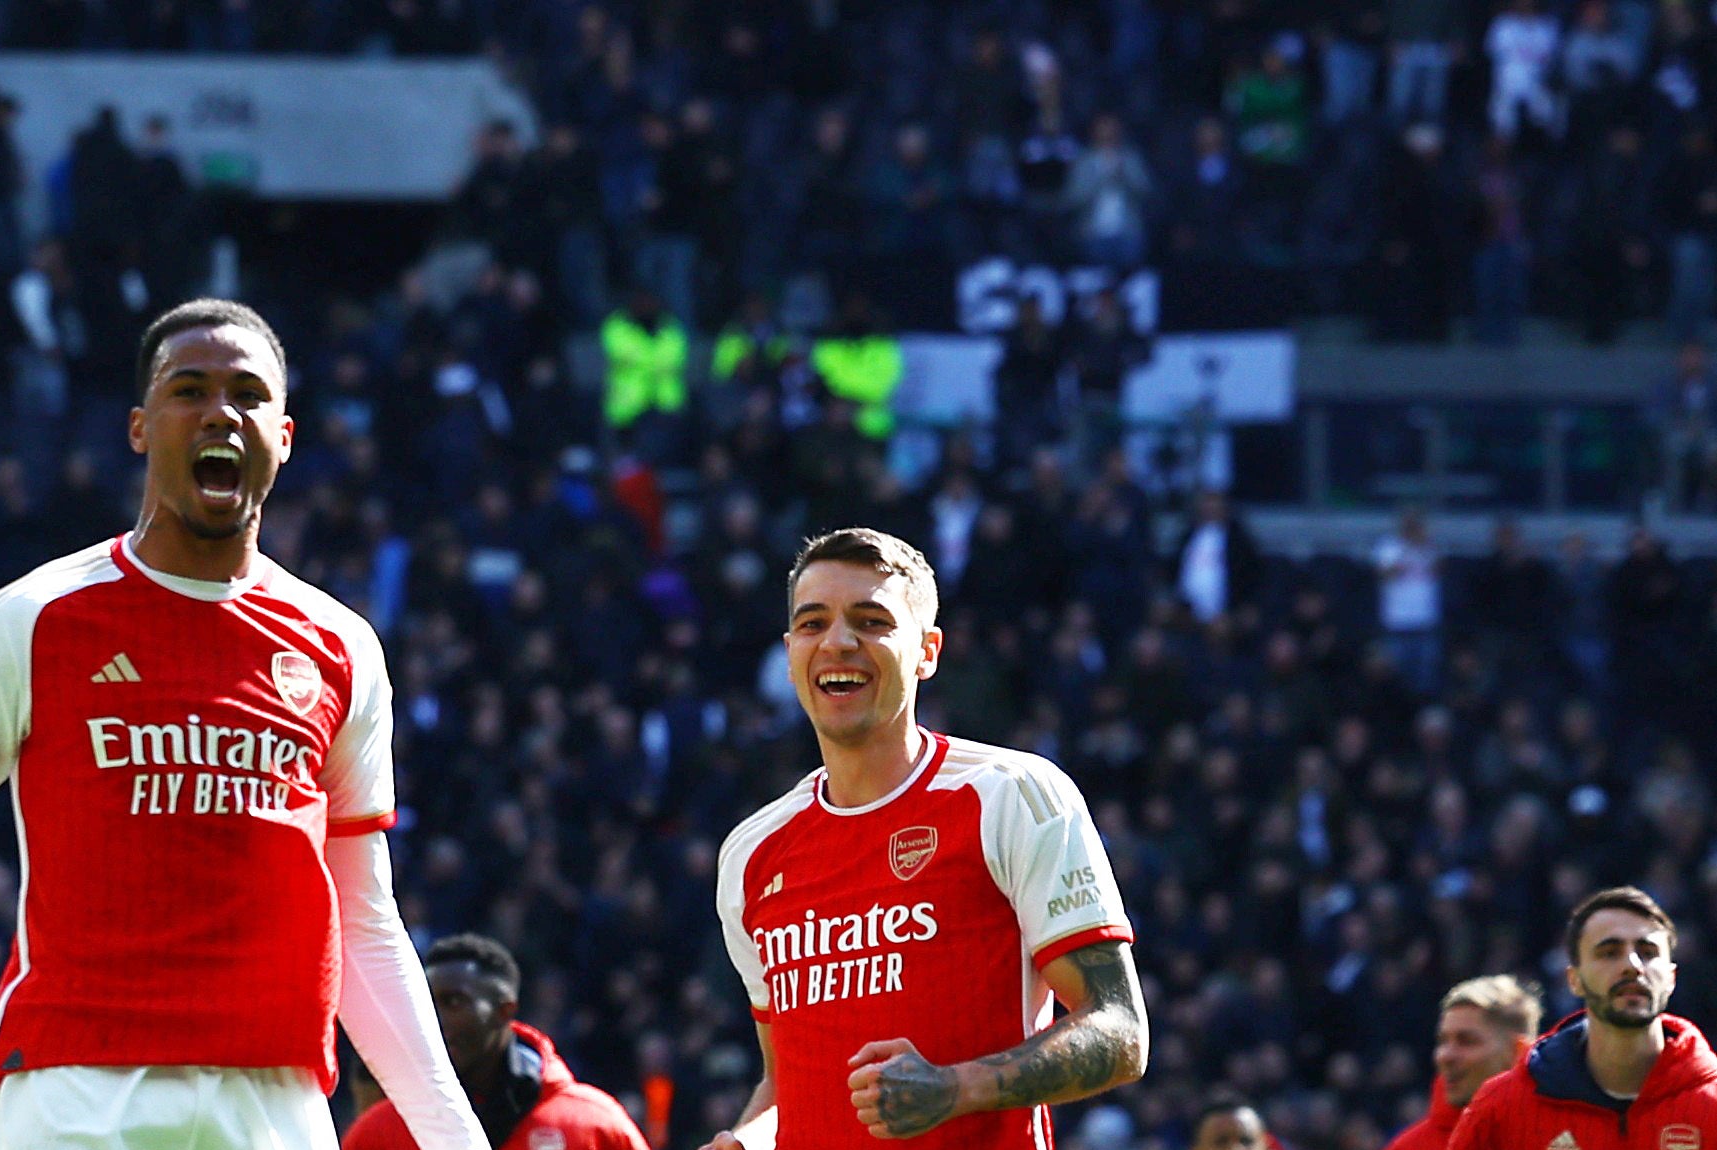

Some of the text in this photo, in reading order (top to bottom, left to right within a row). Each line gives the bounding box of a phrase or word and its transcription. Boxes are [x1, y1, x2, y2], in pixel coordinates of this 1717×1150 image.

[86, 714, 317, 790] Emirates
[130, 773, 292, 815] FLY BETTER
[772, 952, 904, 1015] FLY BETTER
